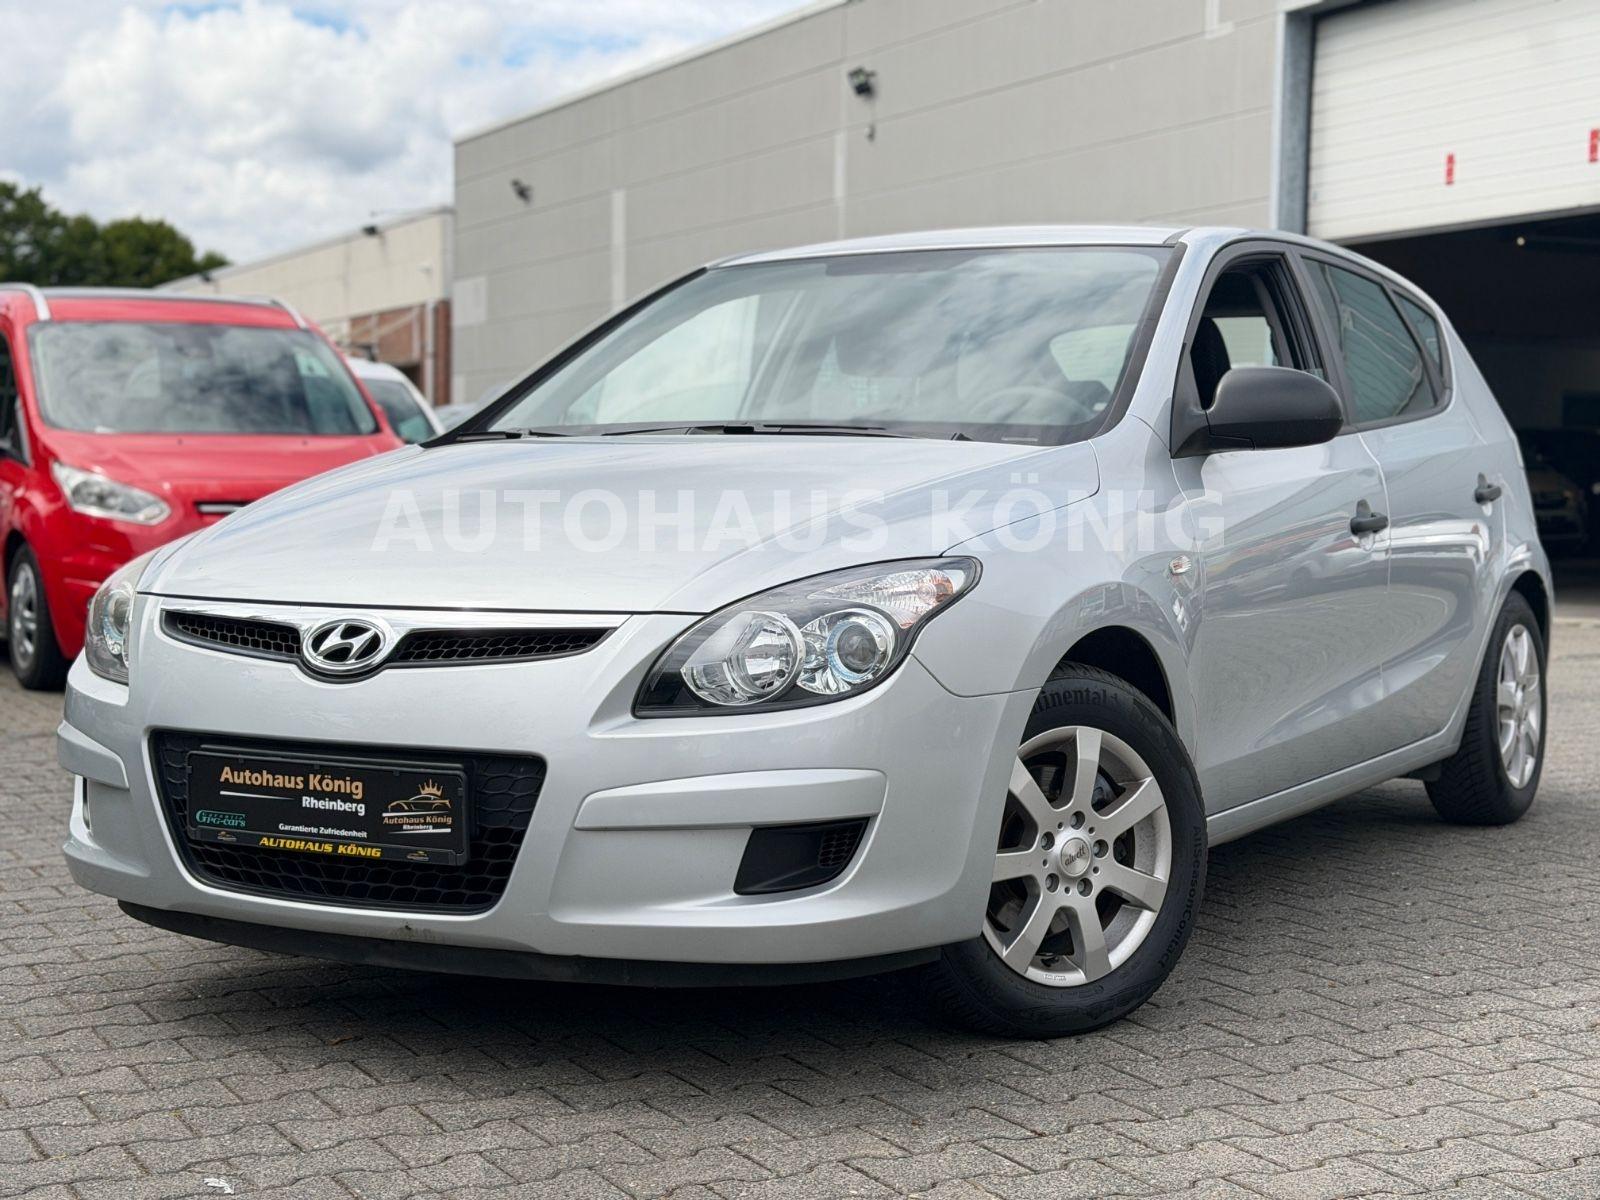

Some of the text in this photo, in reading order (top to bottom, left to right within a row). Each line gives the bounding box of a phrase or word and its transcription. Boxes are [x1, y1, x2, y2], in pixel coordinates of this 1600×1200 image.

[219, 766, 363, 799] Autohaus König
[302, 796, 365, 816] Rheinberg
[383, 815, 452, 825] Autohaus König
[278, 823, 368, 838] Garantierte Zufriedenheit
[259, 837, 382, 857] AUTOHAUS KÖNIG
